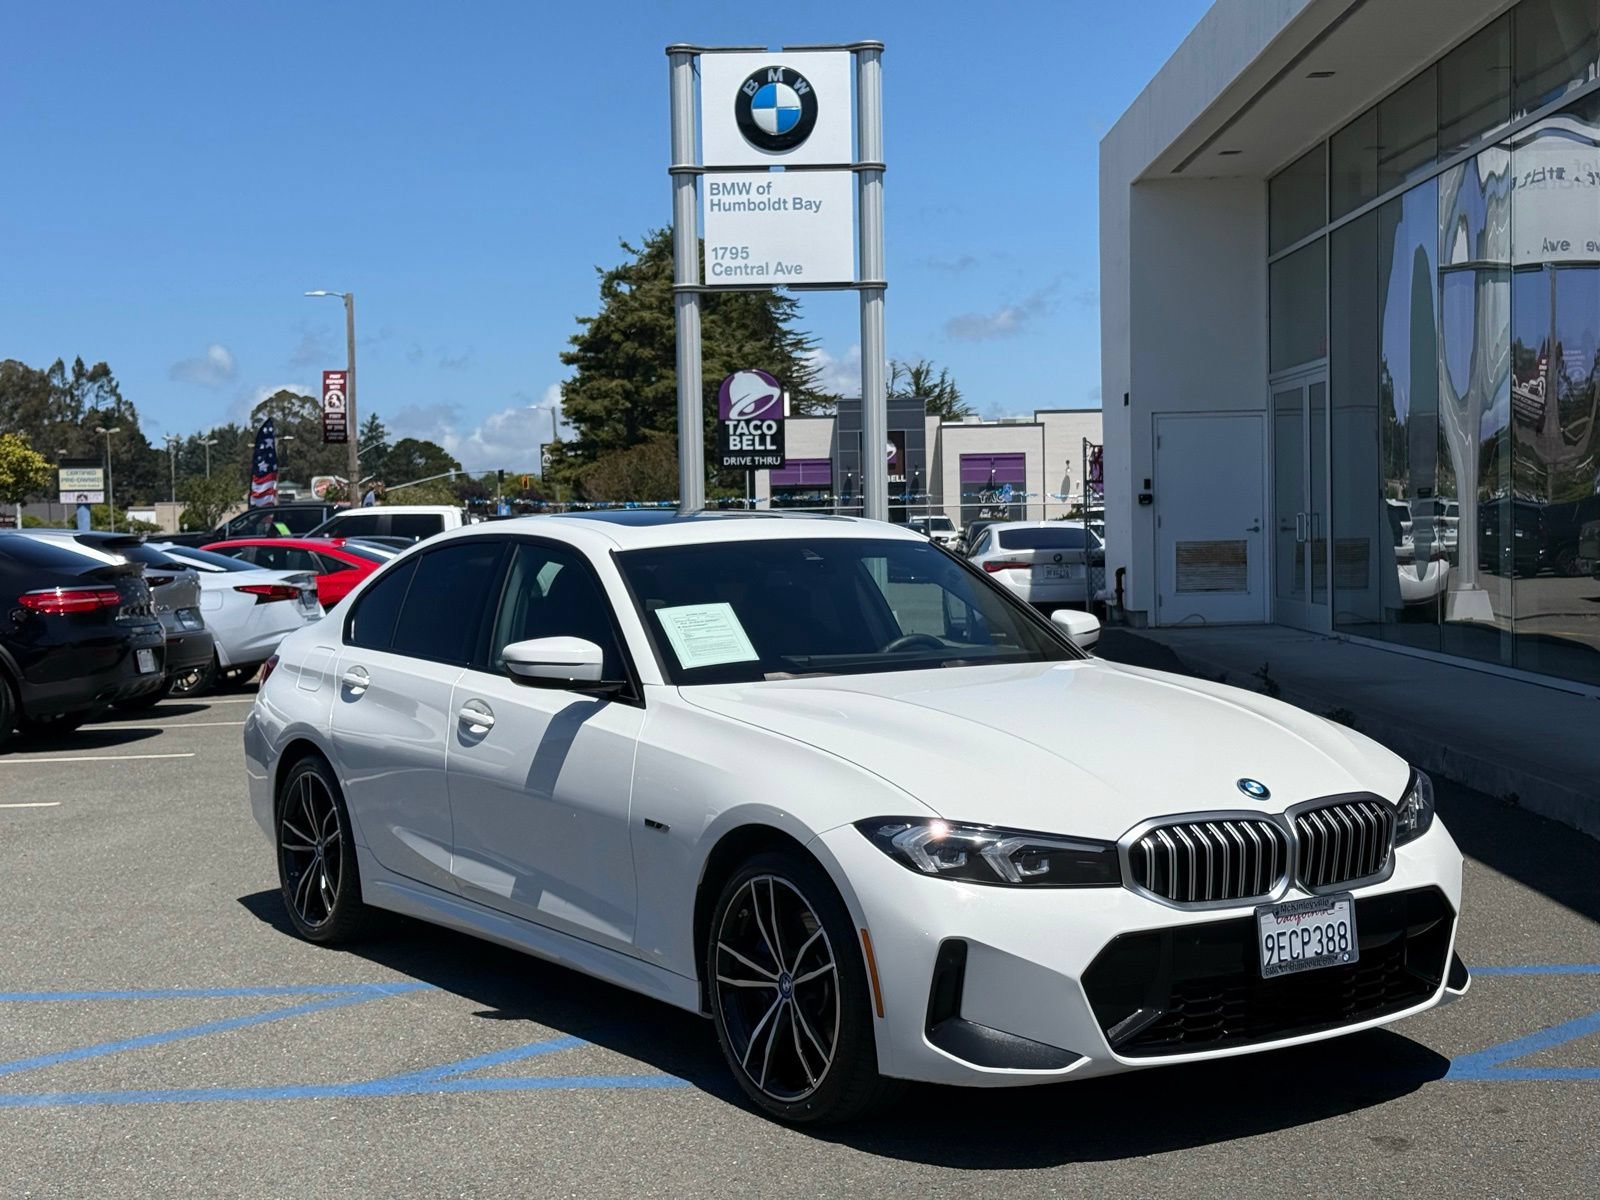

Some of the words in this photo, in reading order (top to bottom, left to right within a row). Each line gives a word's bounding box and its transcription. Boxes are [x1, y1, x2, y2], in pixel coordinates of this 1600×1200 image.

[743, 69, 810, 97] BMW
[709, 182, 752, 196] BMW
[756, 181, 772, 195] of
[710, 198, 788, 212] Humboldt
[792, 197, 822, 213] Bay
[711, 246, 750, 260] 1795
[711, 262, 769, 276] Central
[774, 261, 803, 275] Ave
[725, 420, 777, 435] TACO
[729, 435, 777, 450] BELL
[723, 457, 752, 465] DRIVE
[754, 456, 781, 465] THRU
[1264, 921, 1348, 966] 9ECP388
